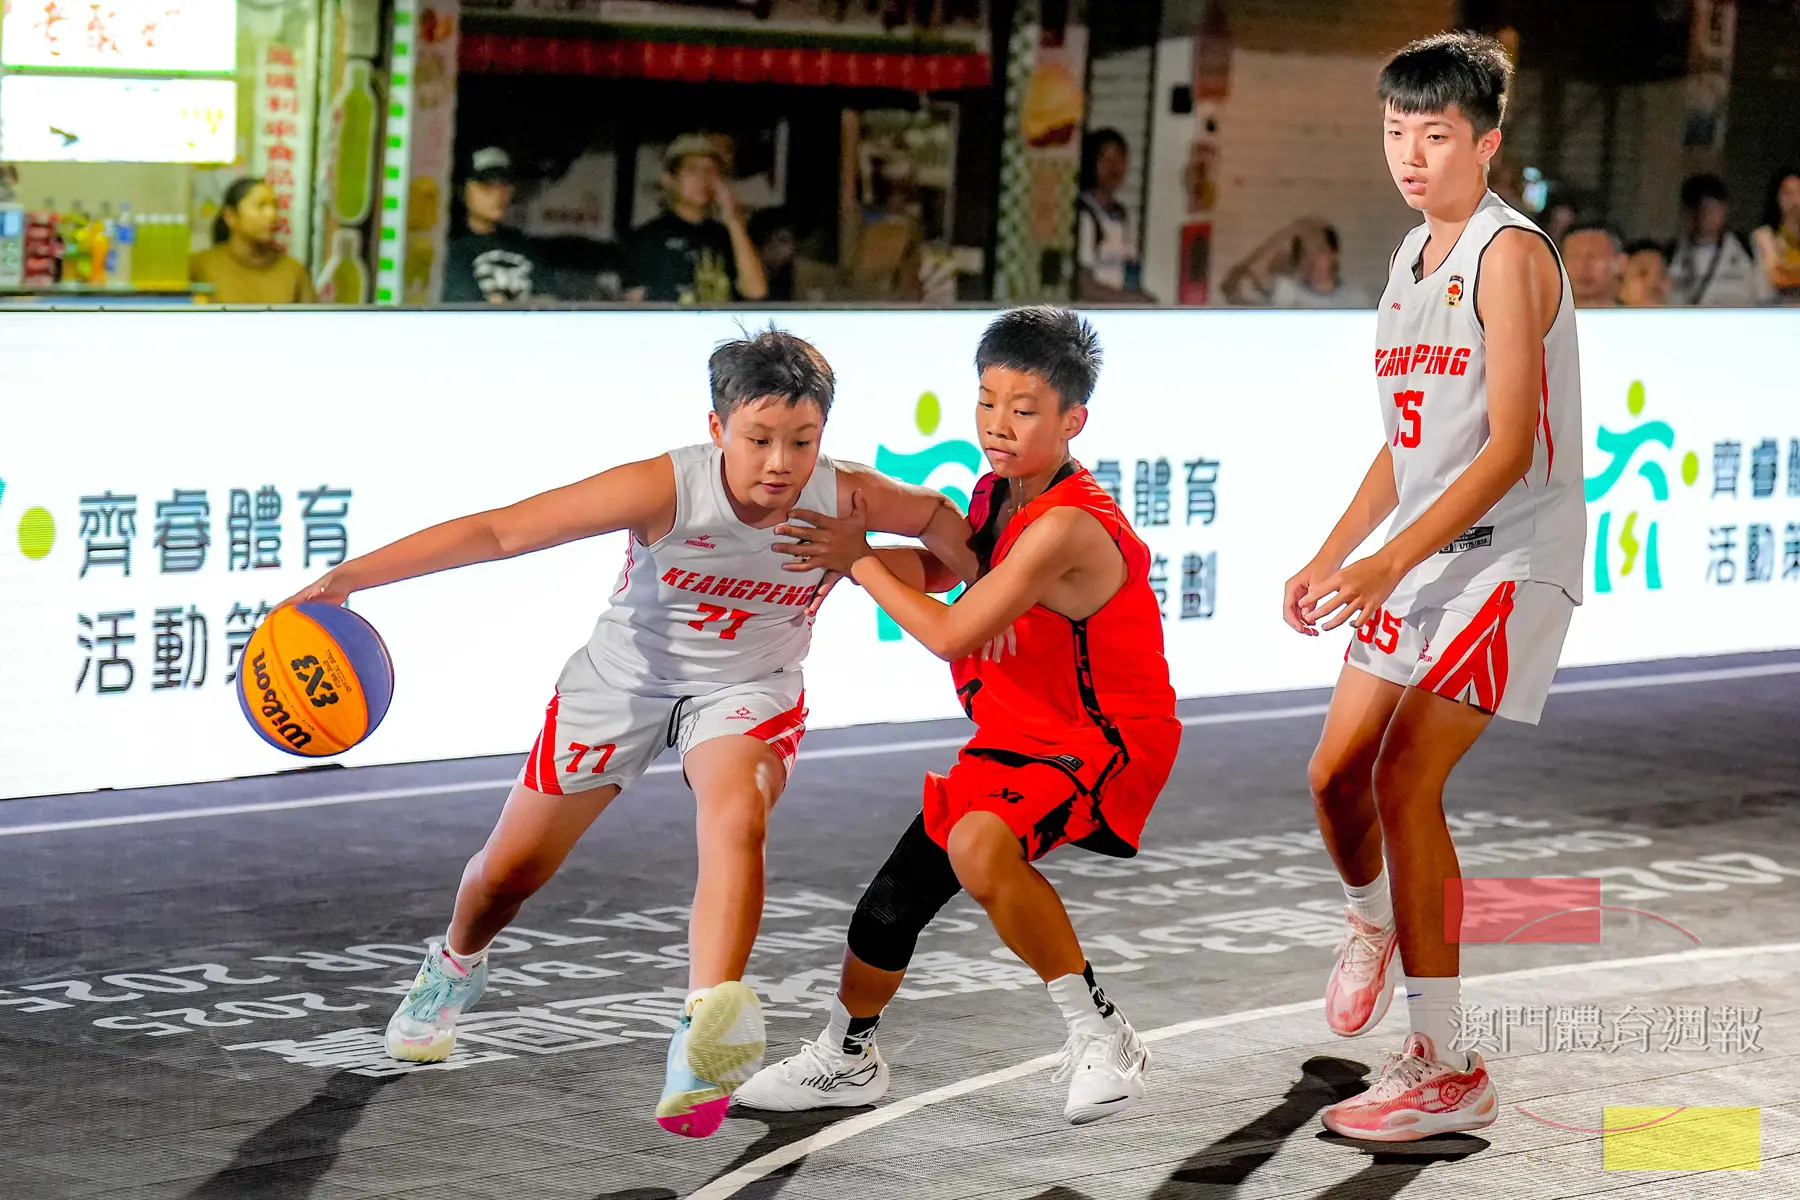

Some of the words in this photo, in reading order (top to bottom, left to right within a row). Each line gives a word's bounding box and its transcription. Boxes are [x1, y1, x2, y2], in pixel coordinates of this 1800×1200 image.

[79, 484, 353, 579] 齊睿體育
[662, 567, 816, 607] KEANGPENG
[688, 603, 758, 641] 77
[252, 648, 312, 750] Wilson
[565, 741, 617, 774] 77
[92, 992, 371, 1037] 2025
